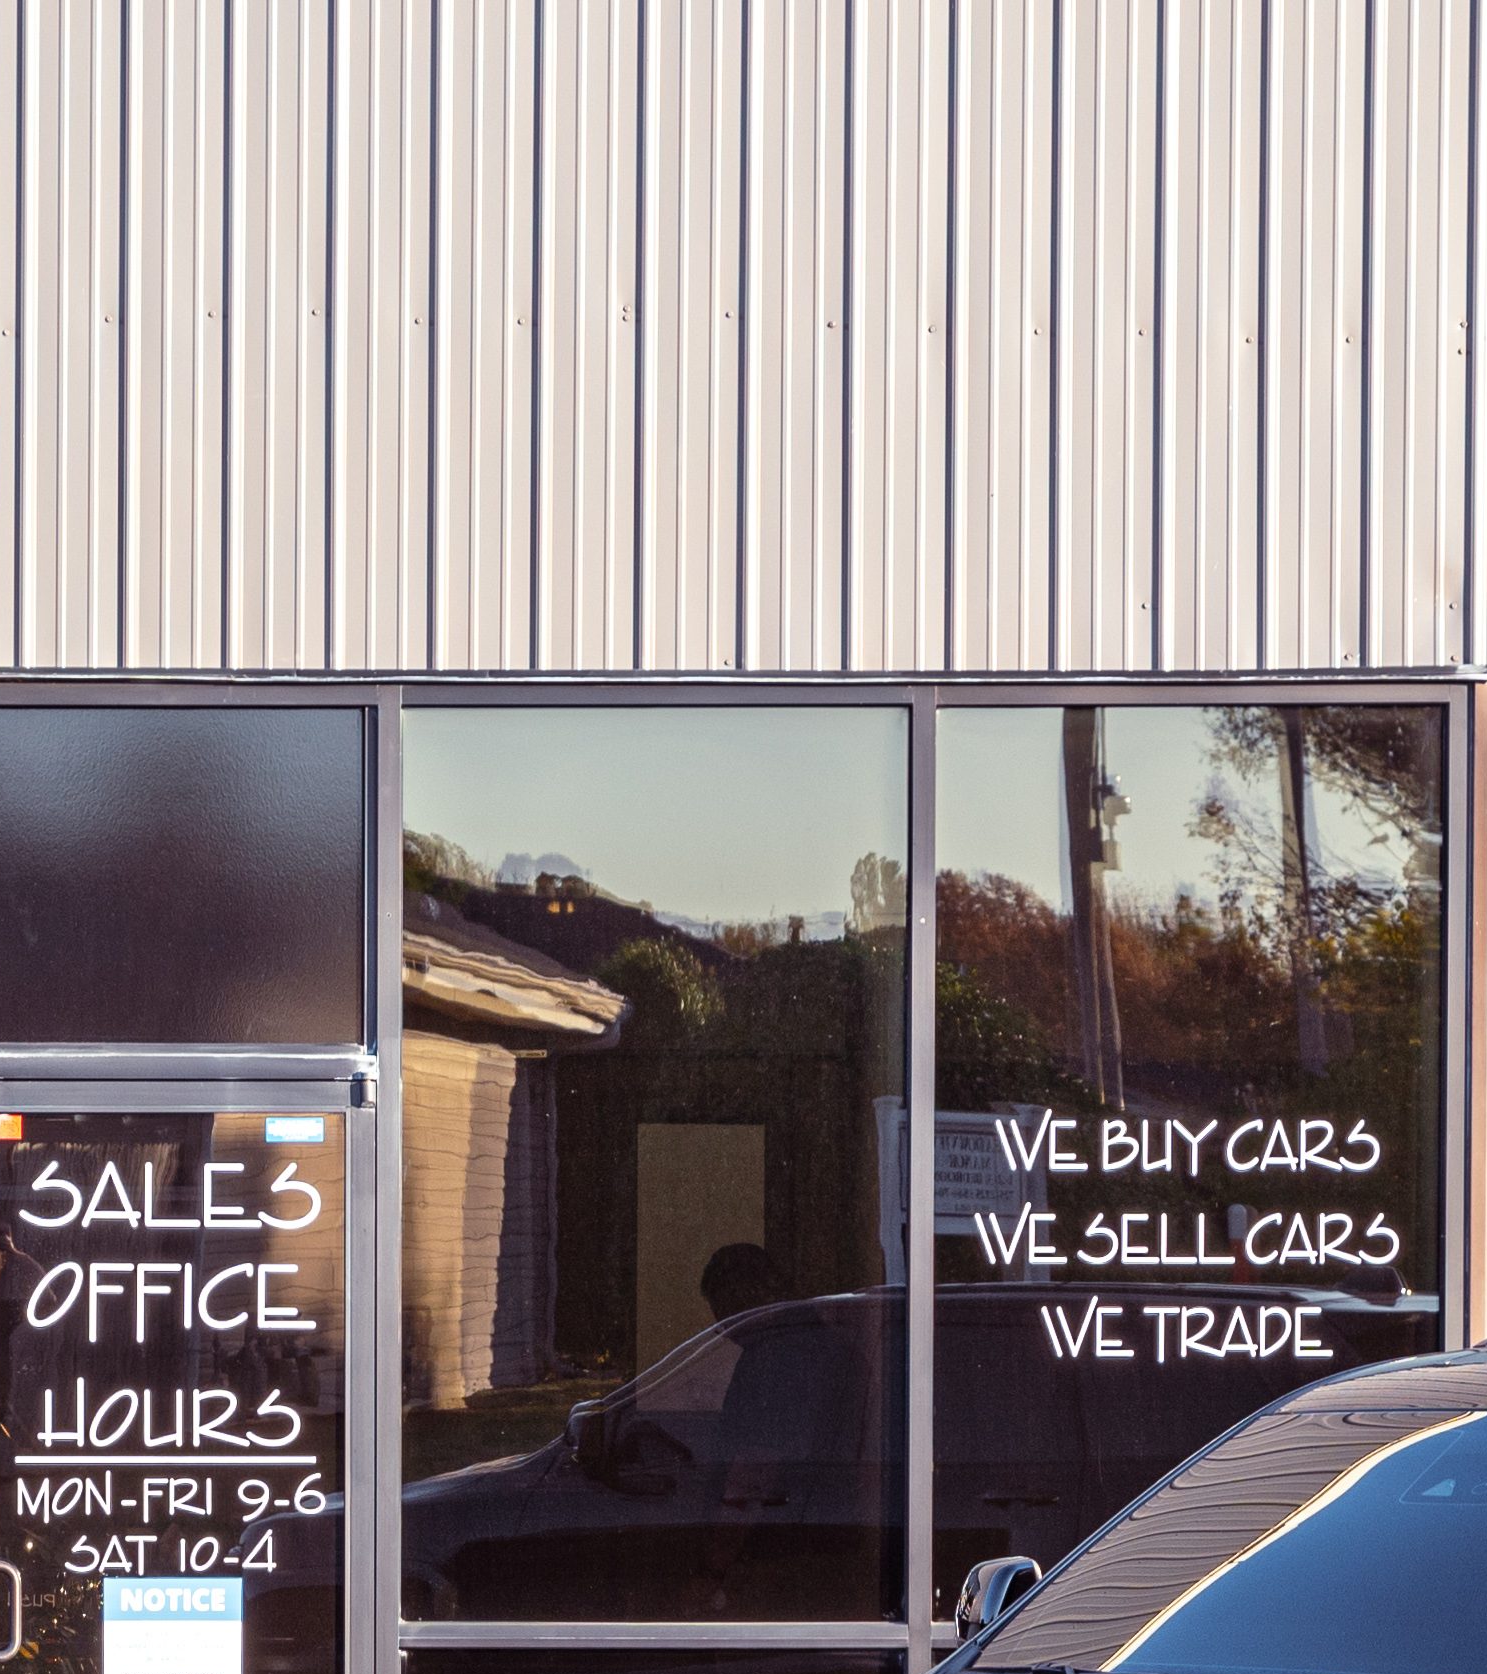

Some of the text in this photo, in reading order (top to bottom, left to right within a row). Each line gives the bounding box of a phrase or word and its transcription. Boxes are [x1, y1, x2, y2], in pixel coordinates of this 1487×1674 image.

[994, 1108, 1382, 1177] WE BUY CARS
[17, 1159, 323, 1232] SALES
[973, 1200, 1401, 1266] WE SELL CARS
[25, 1260, 318, 1344] OFFICE
[1039, 1294, 1334, 1364] WE TRADE
[36, 1375, 302, 1449] HOURS
[16, 1468, 328, 1525] MON-FRI 9-6
[63, 1527, 278, 1577] SAT 10-4
[119, 1587, 227, 1613] NOTICE
